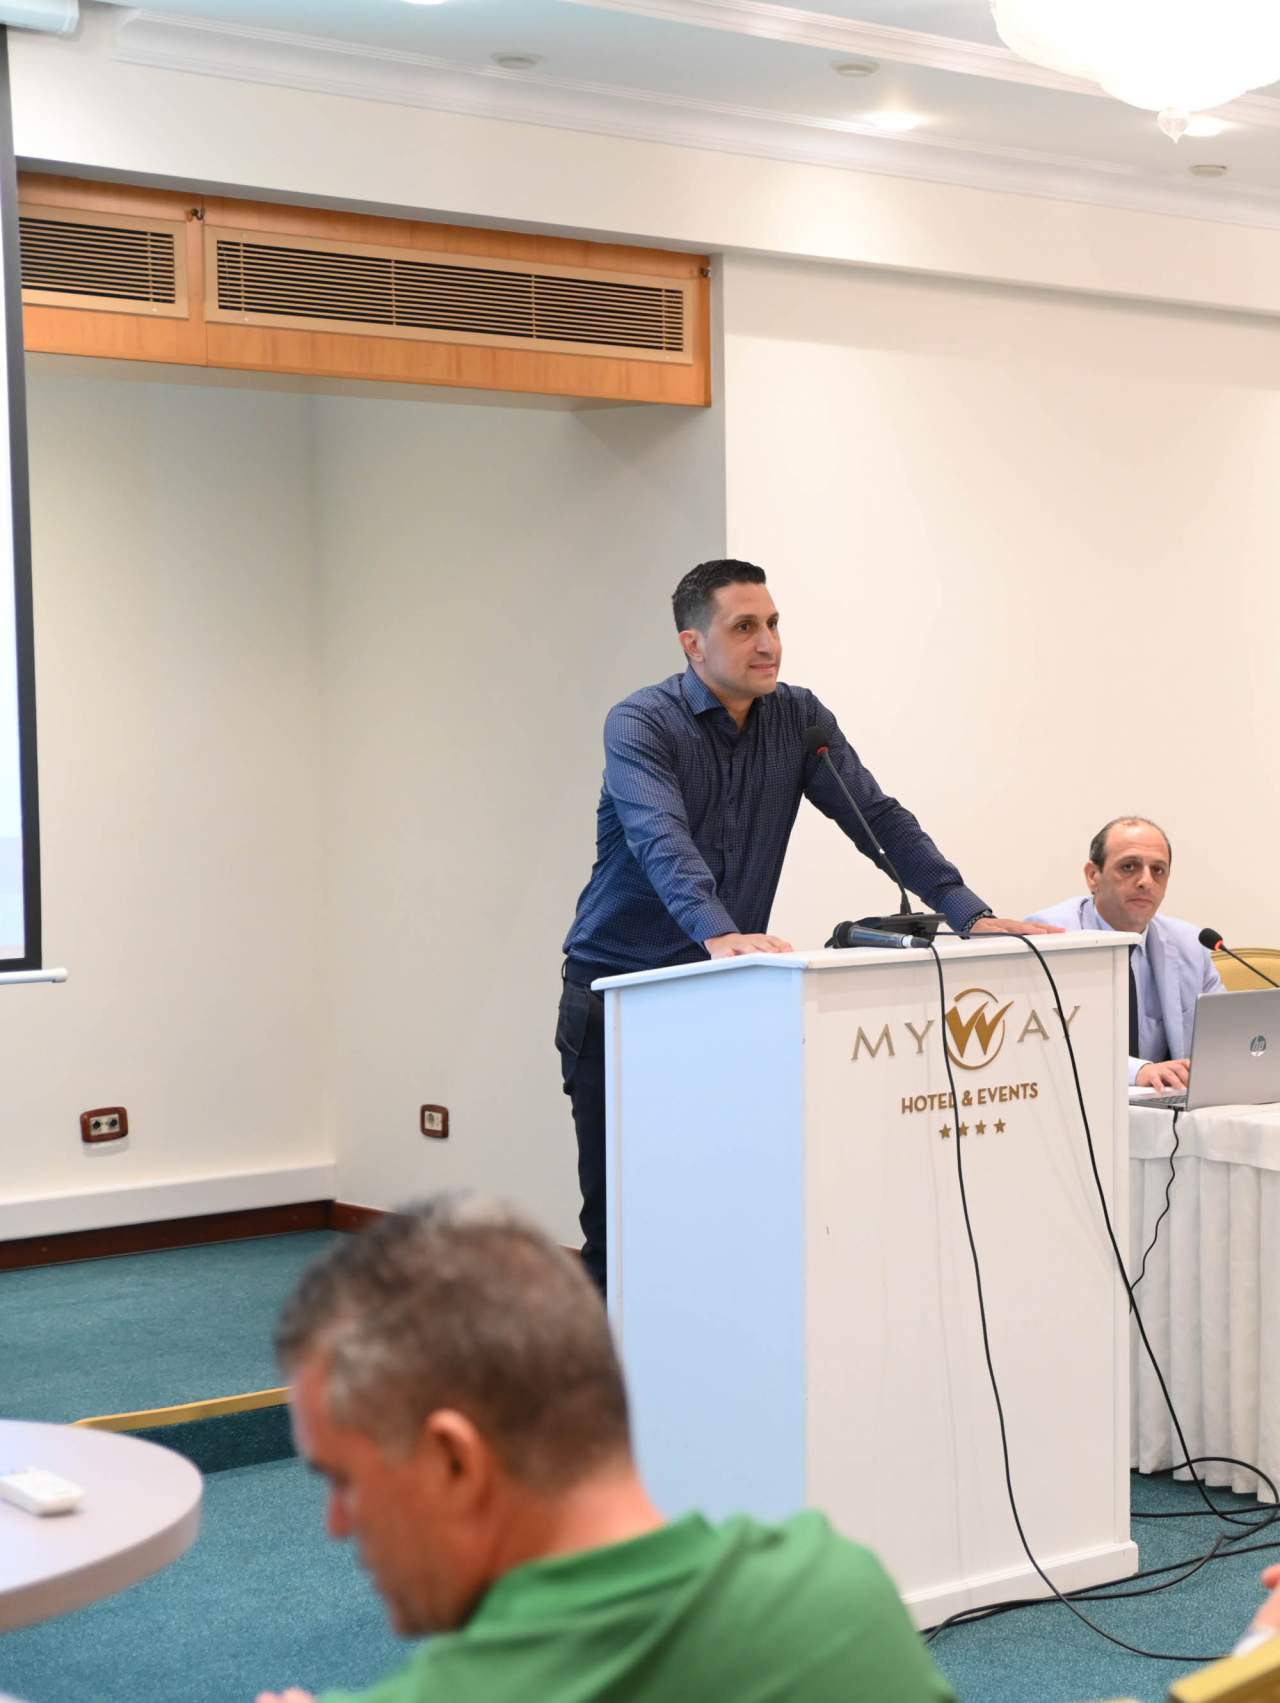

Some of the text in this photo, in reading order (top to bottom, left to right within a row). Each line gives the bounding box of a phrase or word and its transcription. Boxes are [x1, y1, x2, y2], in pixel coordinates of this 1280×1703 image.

[850, 1019, 935, 1061] MY
[961, 1090, 973, 1107] &
[977, 1082, 1039, 1106] EVENTS
